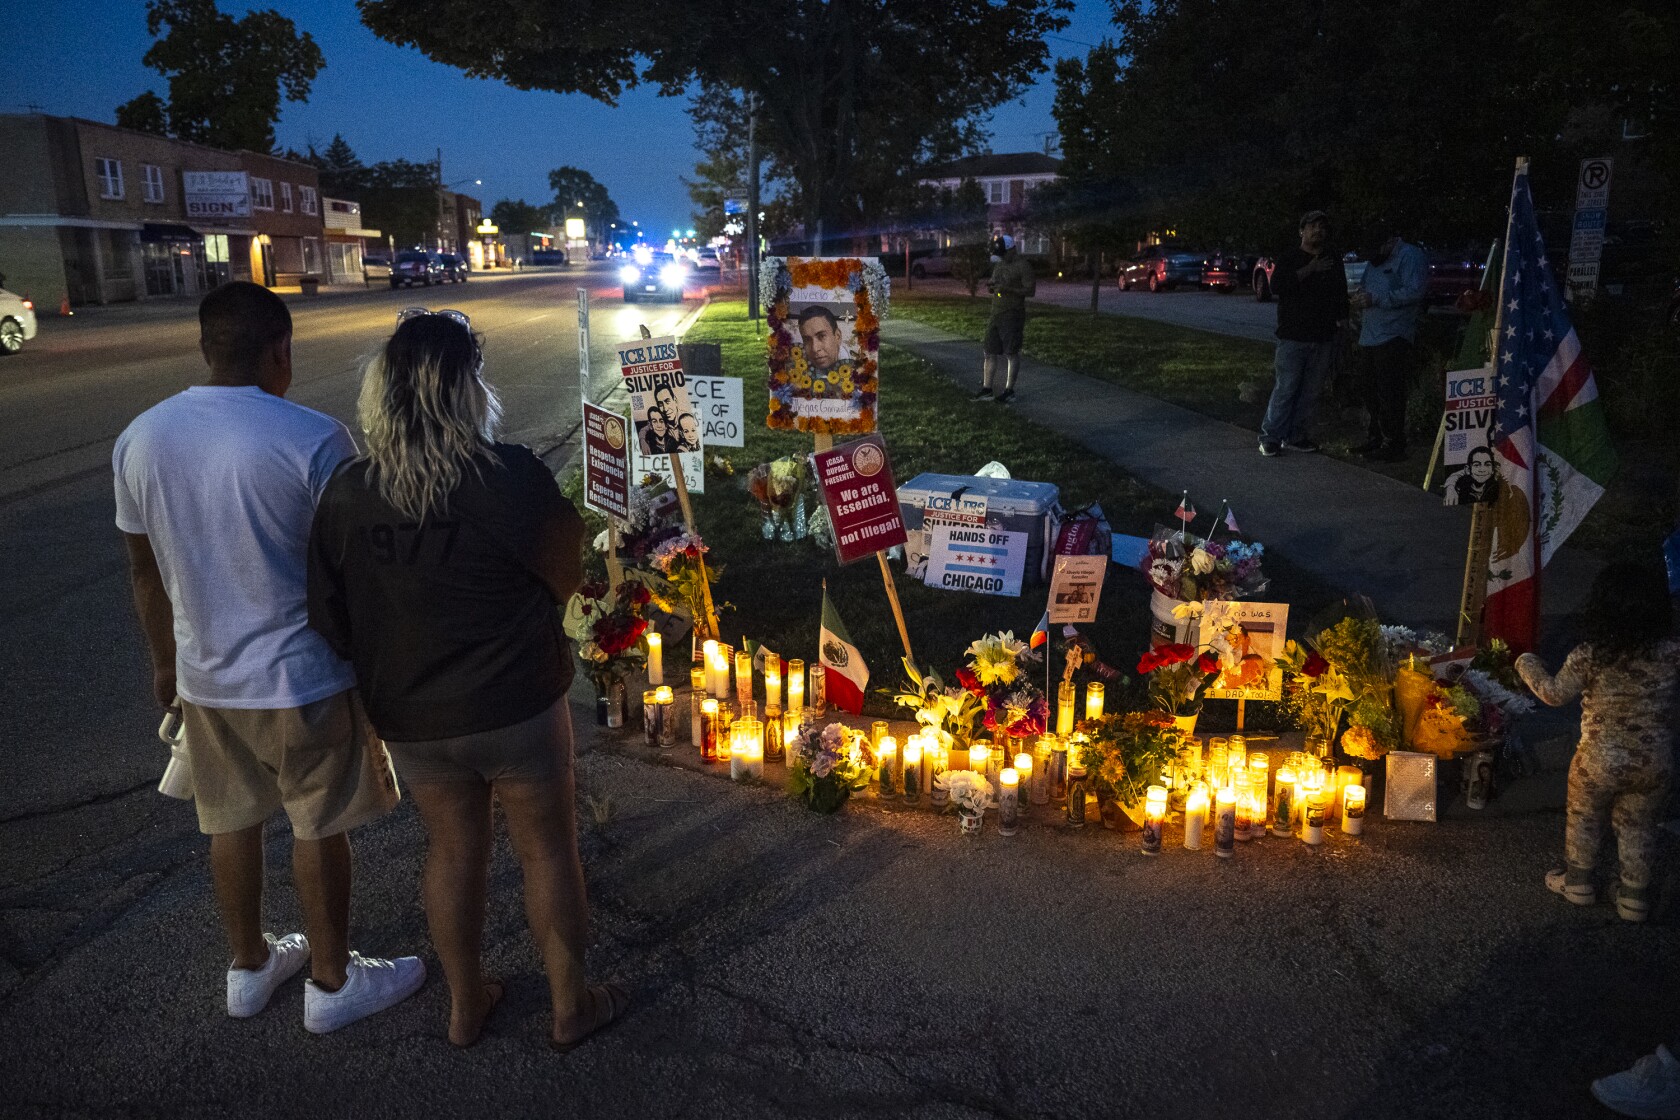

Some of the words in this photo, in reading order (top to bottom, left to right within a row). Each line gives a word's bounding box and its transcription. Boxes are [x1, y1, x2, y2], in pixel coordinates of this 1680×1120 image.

[189, 202, 234, 213] SIGN
[1577, 220, 1602, 229] ROUTE
[1570, 266, 1596, 276] PARALLEL
[618, 347, 647, 366] ICE
[647, 343, 677, 362] LIES
[630, 364, 659, 375] JUSTICE
[658, 362, 675, 372] FOR
[625, 371, 686, 393] SILVERIO
[1448, 377, 1485, 398] ICE
[711, 404, 730, 418] OF
[589, 444, 615, 464] Respeta
[616, 457, 625, 469] mi
[638, 455, 670, 473] ICE
[825, 455, 845, 468] ¡CASA
[591, 456, 624, 480] Existencia
[825, 463, 849, 477] DUPAGE
[824, 470, 856, 487] PRESENTE!
[592, 480, 614, 499] Espera
[615, 492, 624, 504] mi
[840, 489, 859, 503] We
[860, 482, 880, 497] are
[589, 490, 627, 516] Resistencia
[836, 491, 890, 517] Essential,
[927, 496, 952, 511] ICE
[930, 510, 961, 521] JUSTICE
[961, 514, 979, 523] FOR
[840, 530, 860, 546] not
[860, 516, 901, 540] Illegal!
[949, 530, 986, 543] HANDS
[988, 533, 1010, 546] OFF
[1062, 522, 1082, 555] ington
[942, 573, 1004, 592] CHICAGO
